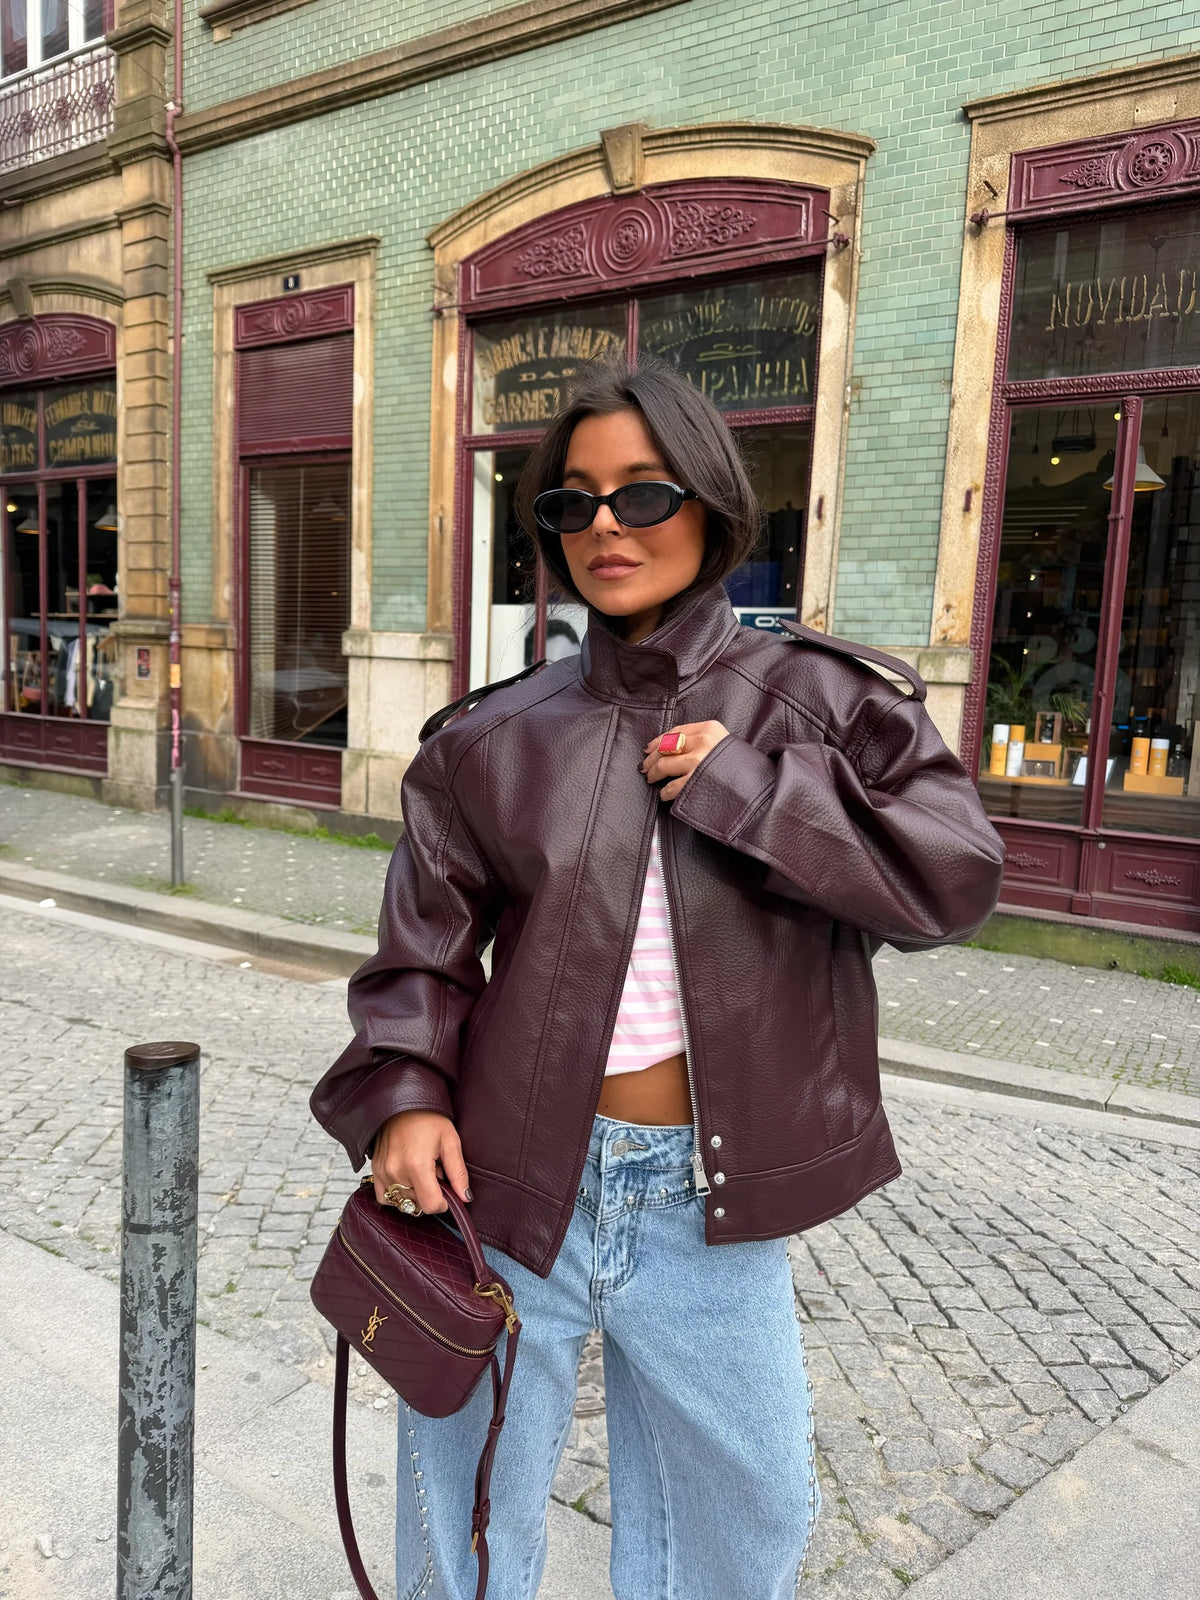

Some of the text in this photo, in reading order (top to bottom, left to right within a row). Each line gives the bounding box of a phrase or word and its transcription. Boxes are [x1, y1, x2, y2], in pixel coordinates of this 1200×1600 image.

[1045, 270, 1200, 331] NOVIDAD
[49, 431, 117, 462] COMPANHI
[361, 1305, 389, 1353] YSL
